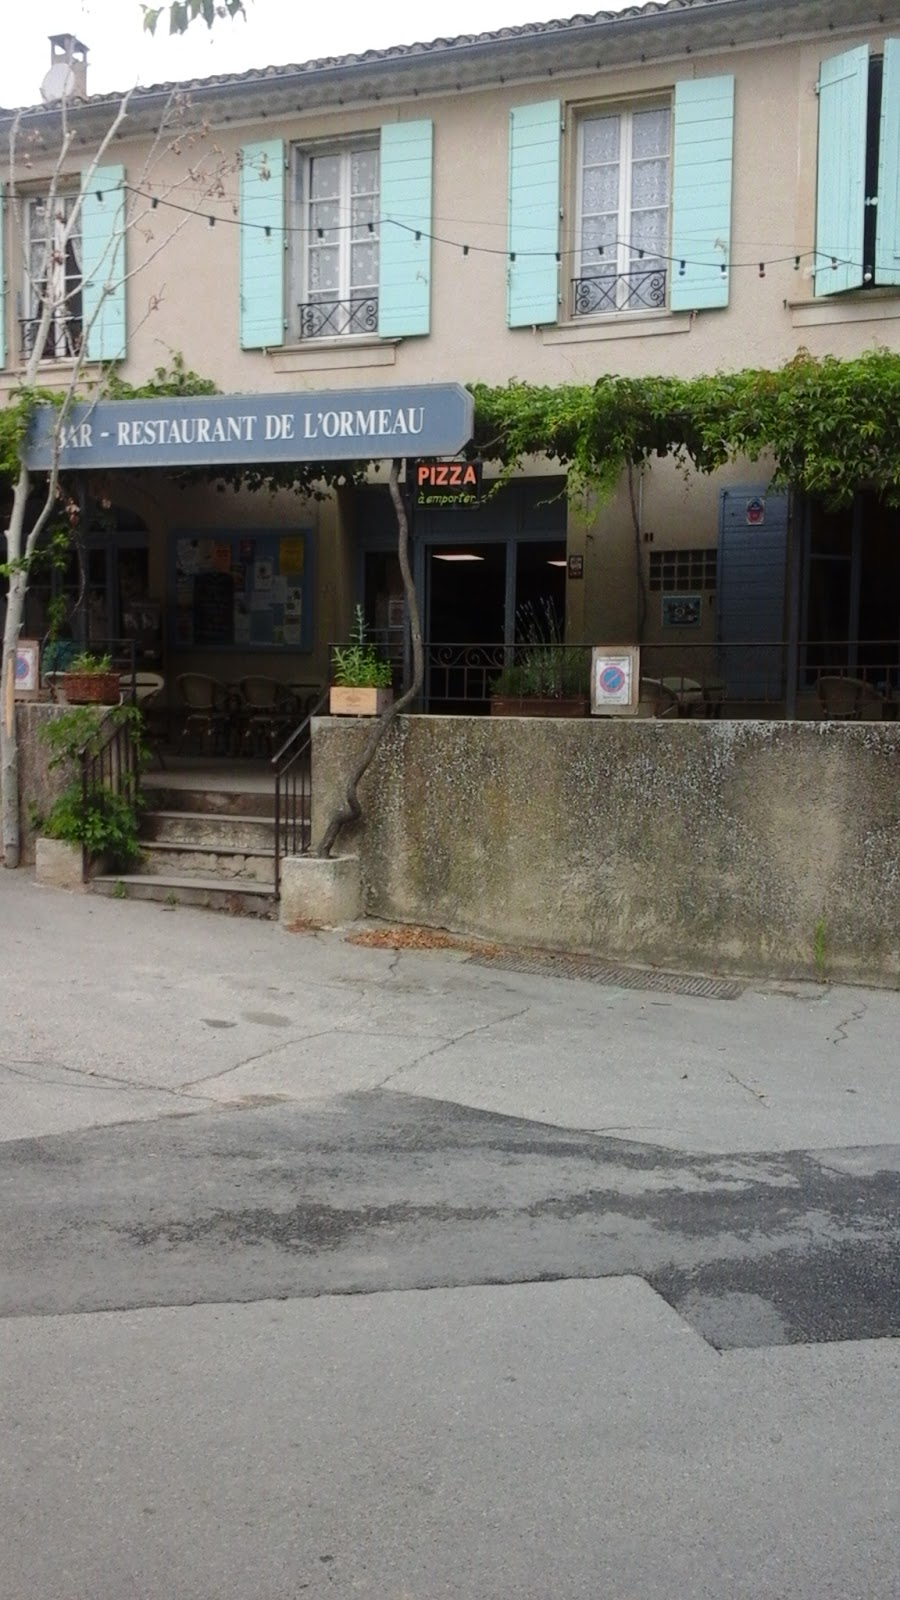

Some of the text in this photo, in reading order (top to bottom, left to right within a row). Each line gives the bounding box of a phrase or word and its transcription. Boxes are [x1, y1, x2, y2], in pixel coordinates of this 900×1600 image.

[58, 423, 92, 448] BAR
[117, 416, 257, 446] RESTAURANT
[264, 414, 295, 440] DE
[303, 407, 425, 438] L'ORMEAU
[418, 465, 476, 486] PIZZA
[426, 493, 476, 506] emporter
